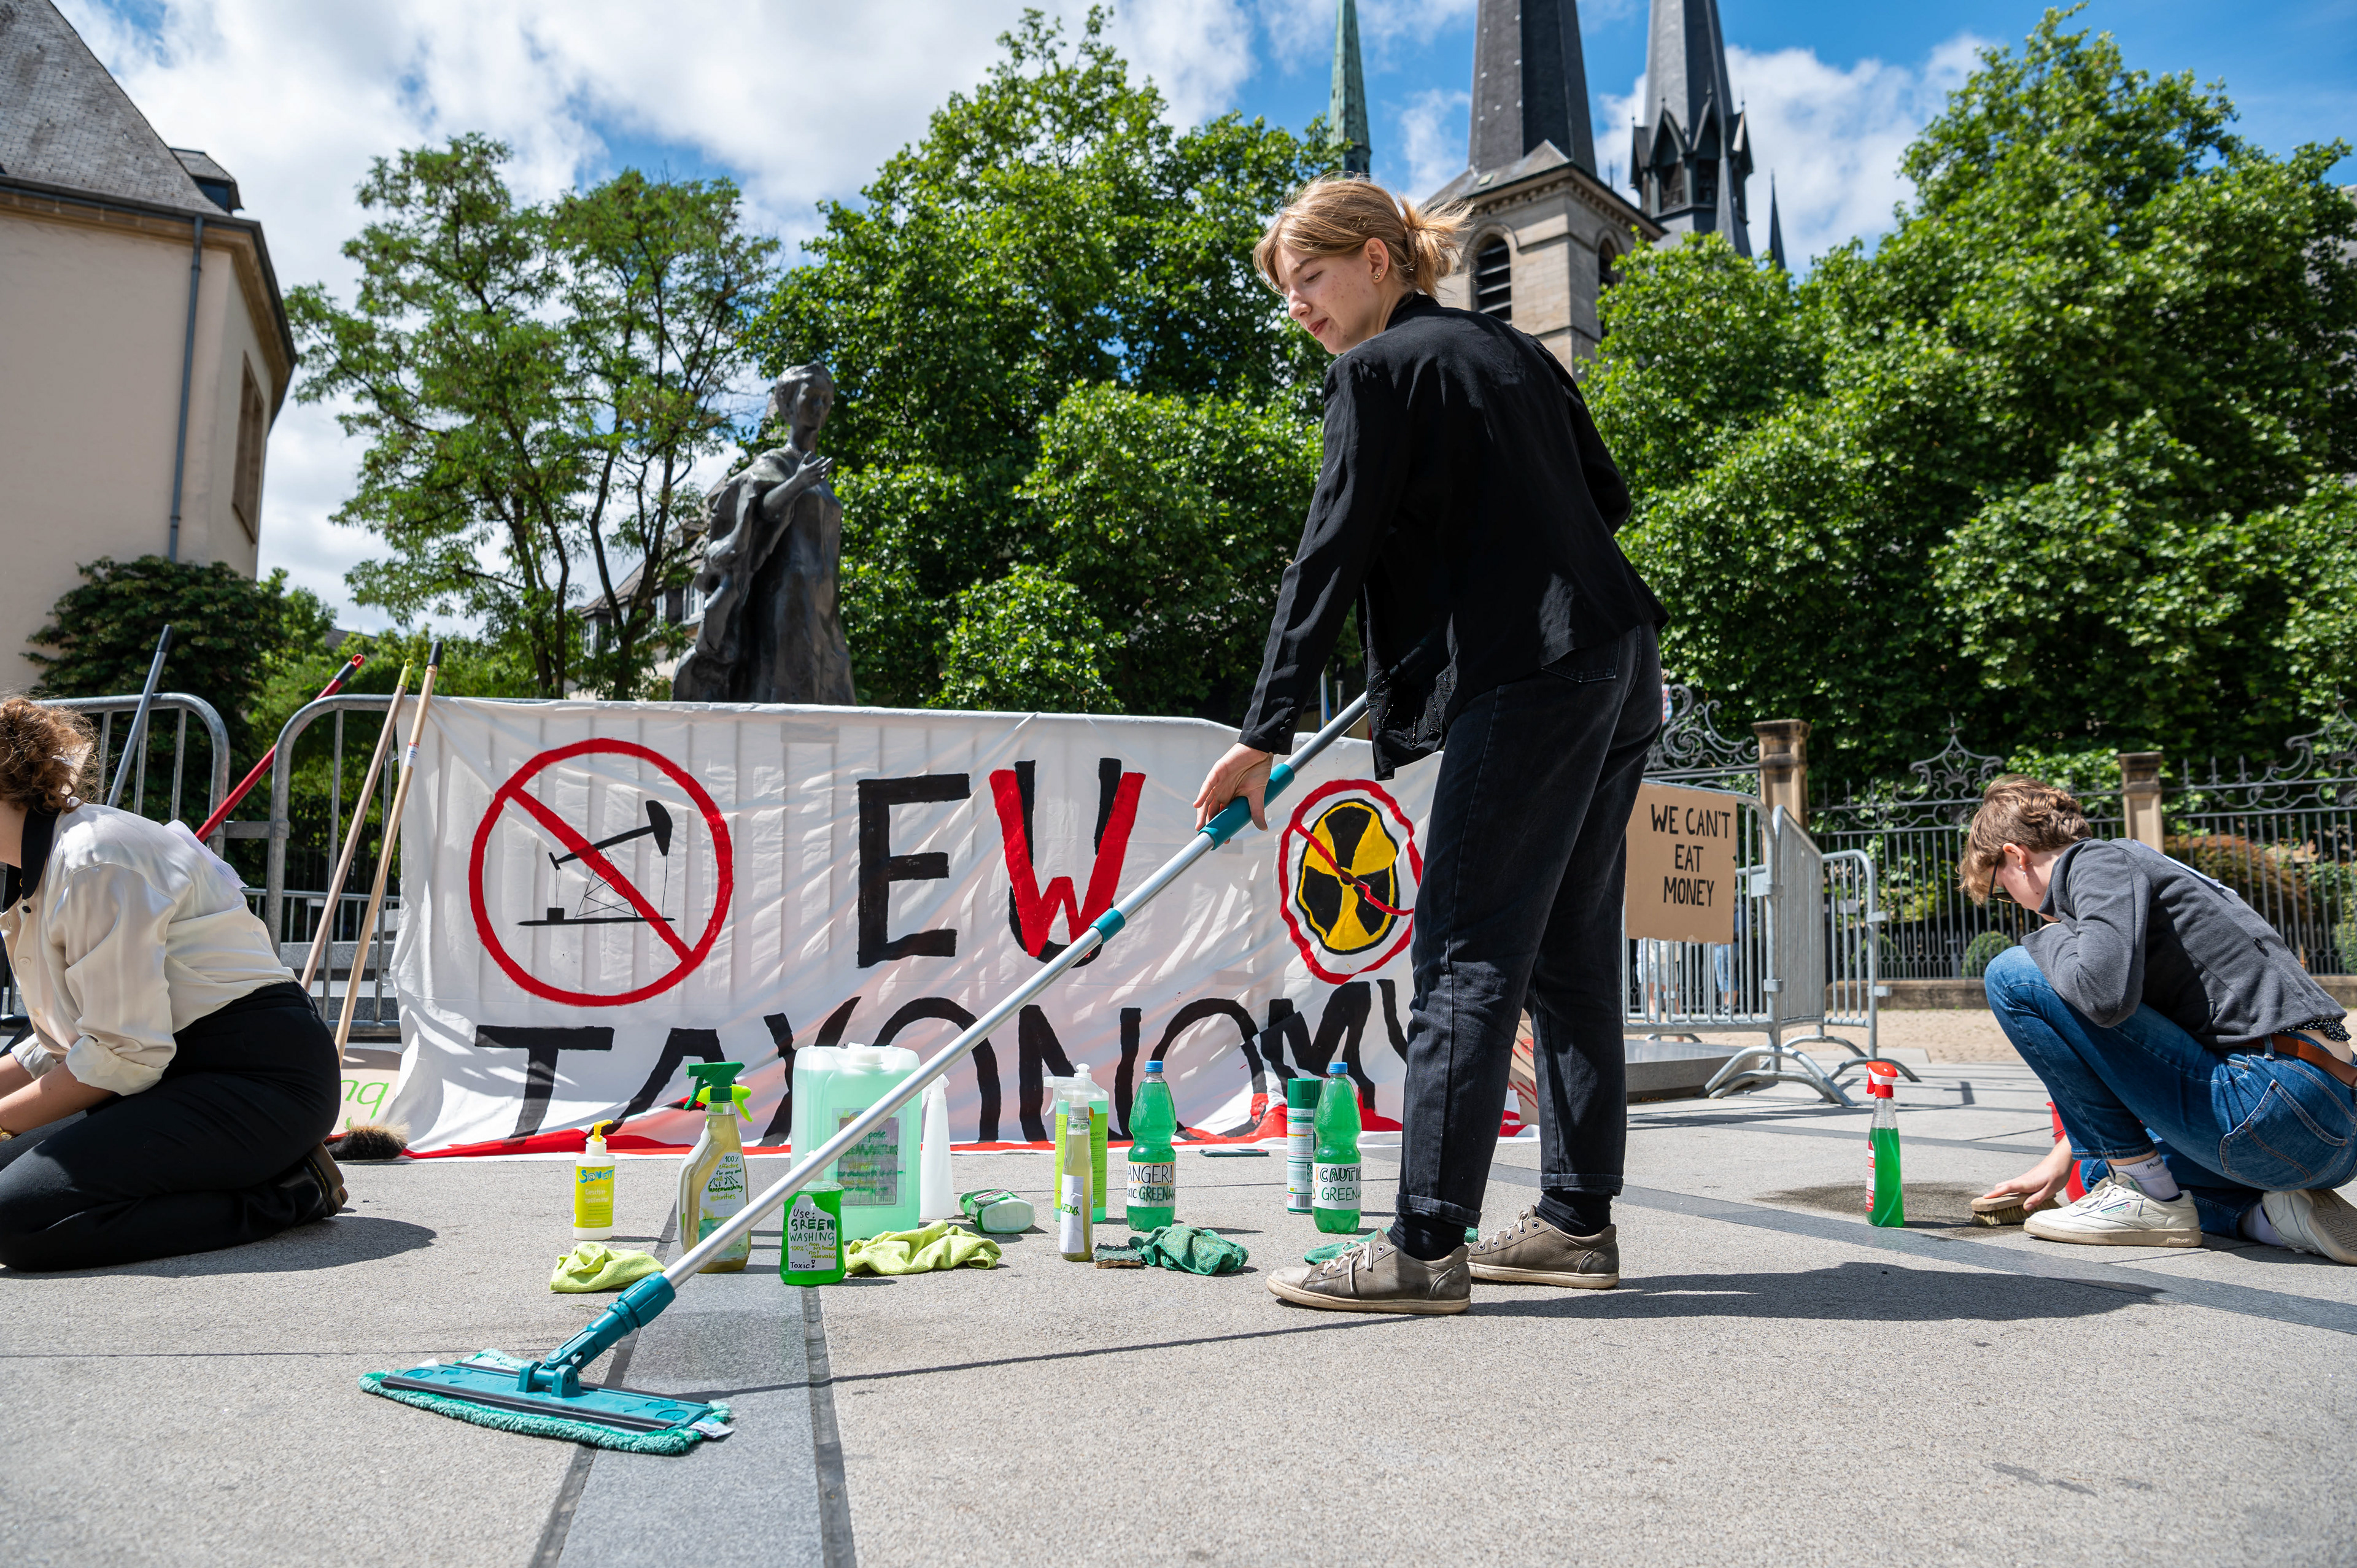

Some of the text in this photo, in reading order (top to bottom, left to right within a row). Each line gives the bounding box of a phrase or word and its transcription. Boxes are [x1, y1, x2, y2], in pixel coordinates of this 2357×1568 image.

[1651, 803, 1731, 839] WE CAN'T
[1674, 843, 1704, 873] EAT
[1663, 876, 1715, 907] MONEY
[865, 1130, 886, 1143] pose
[793, 1208, 815, 1219] Use:
[2102, 1204, 2126, 1215] Reebok
[791, 1218, 835, 1231] GREEN
[789, 1232, 835, 1246] WASHING
[790, 1259, 816, 1269] Toxic!
